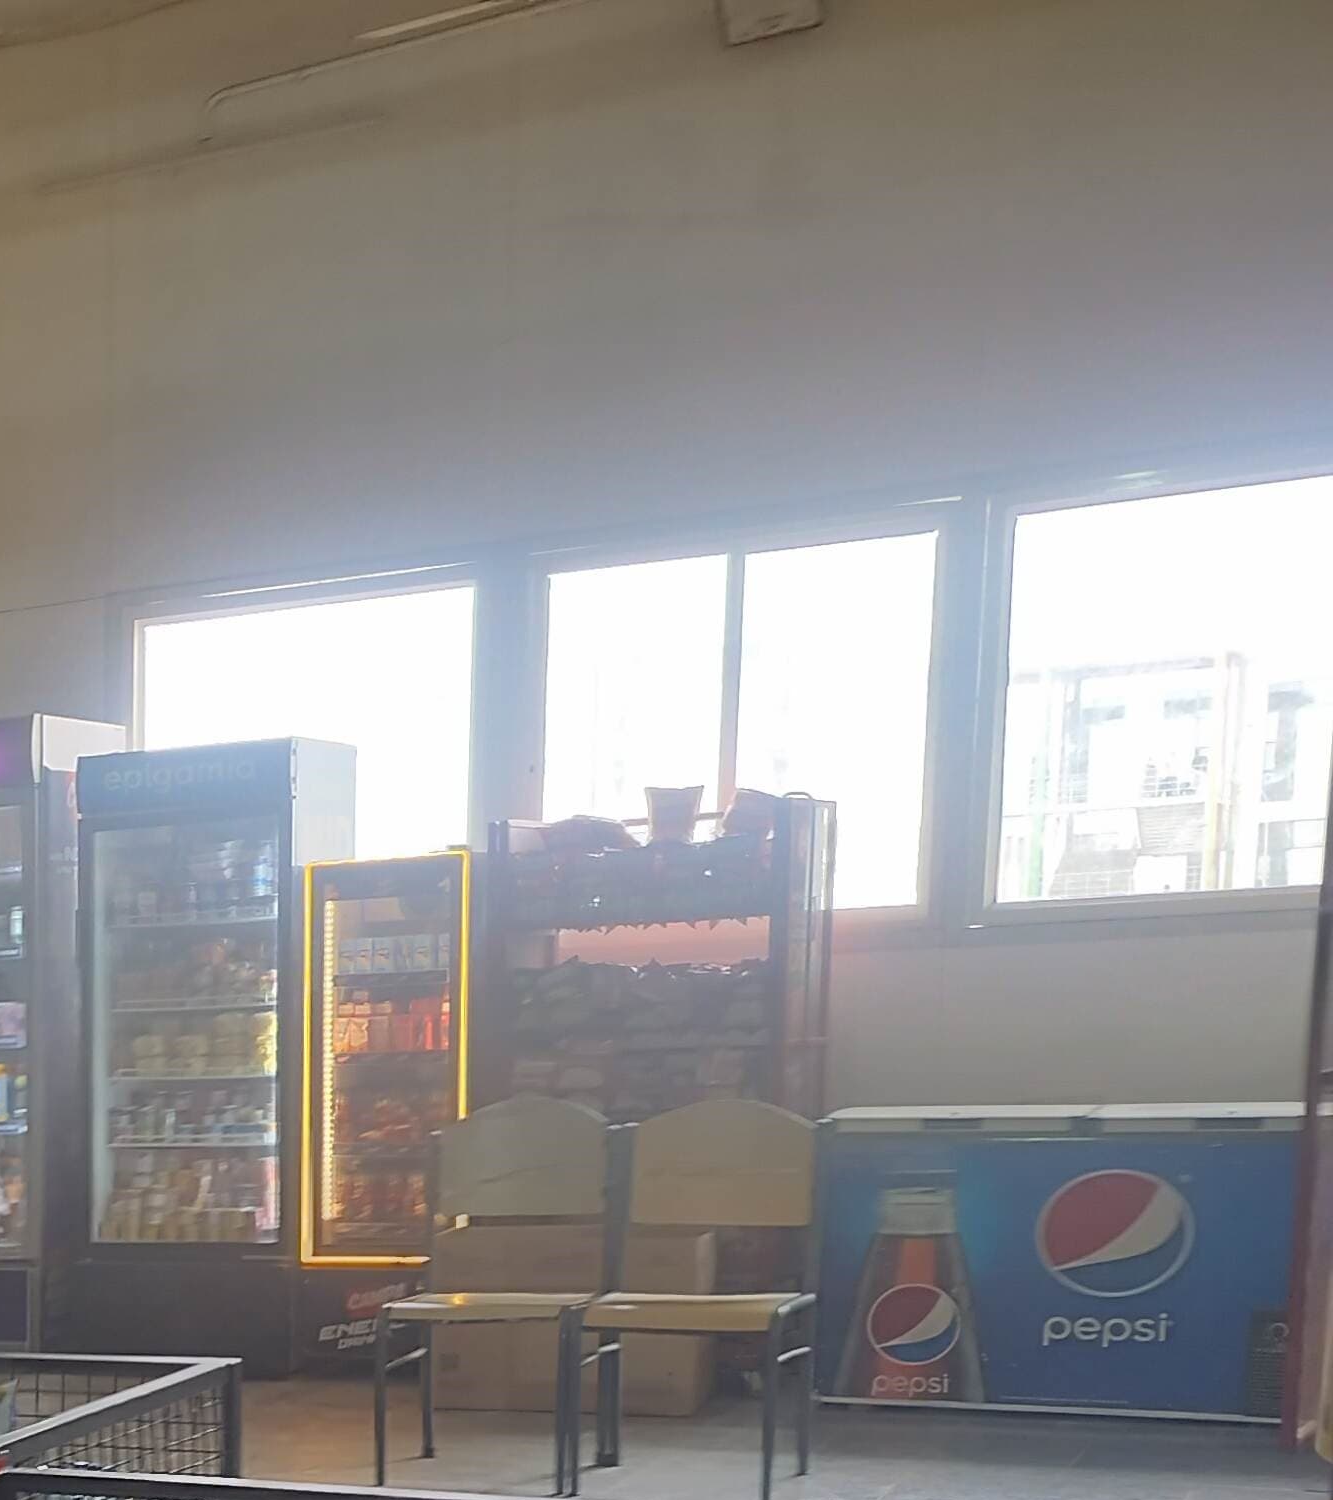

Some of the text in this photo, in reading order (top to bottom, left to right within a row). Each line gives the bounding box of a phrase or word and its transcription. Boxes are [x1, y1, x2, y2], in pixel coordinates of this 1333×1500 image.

[104, 757, 256, 793] epigamia
[1041, 1313, 1169, 1347] pepsi
[871, 1373, 950, 1397] pepsi
